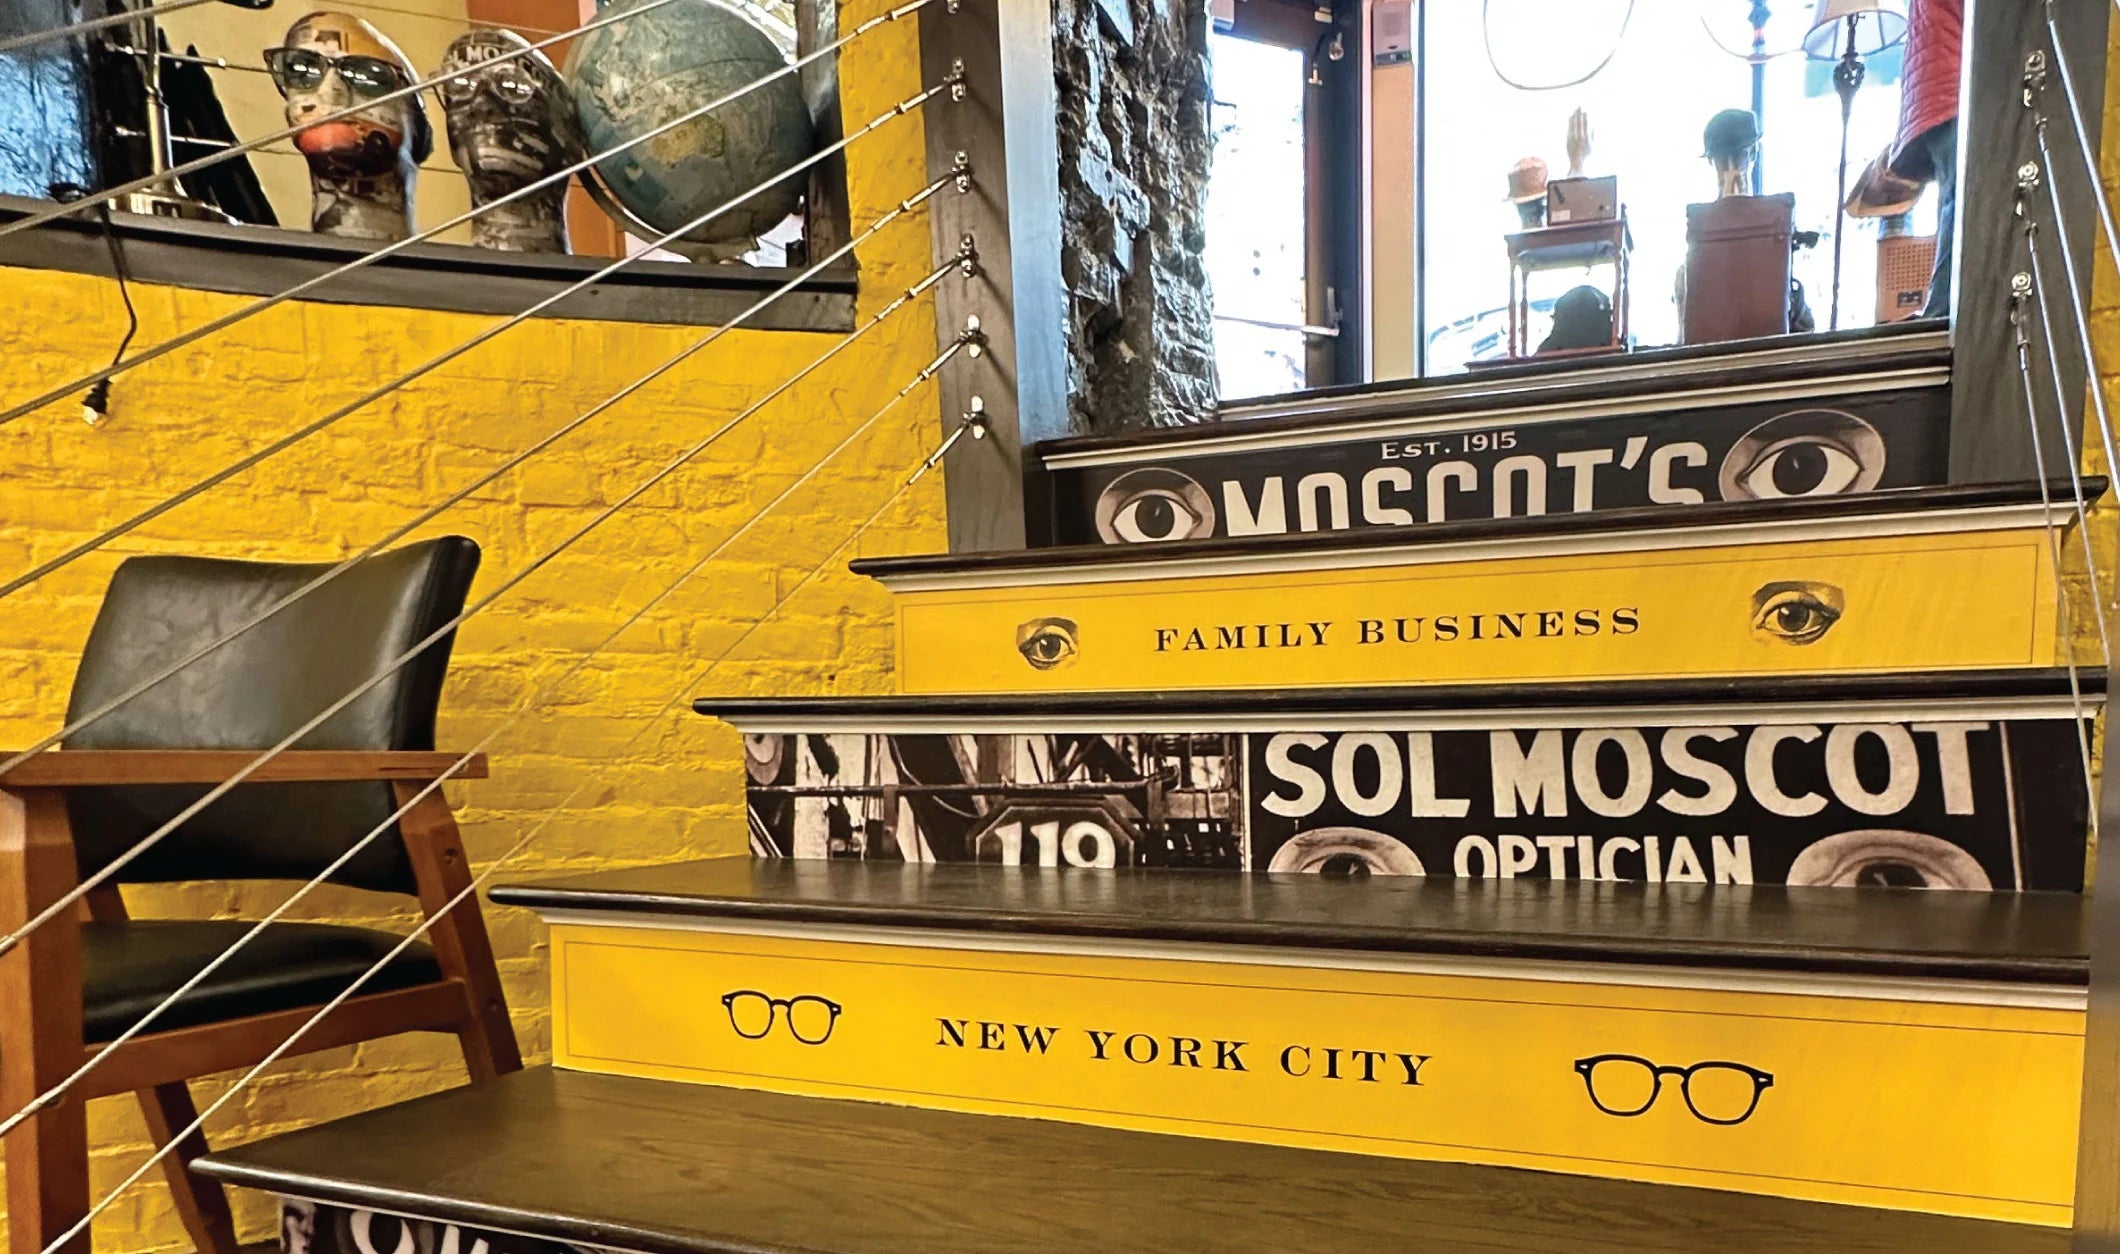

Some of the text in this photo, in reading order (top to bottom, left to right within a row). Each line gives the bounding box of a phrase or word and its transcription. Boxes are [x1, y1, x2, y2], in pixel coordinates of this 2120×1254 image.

[1381, 431, 1518, 460] EST. 1915
[1222, 436, 1708, 537] MOSCOT'S
[1154, 607, 1641, 652] FAMILY BUSINESS
[1260, 721, 1990, 818] SOL MOSCOT
[994, 821, 1116, 869] 119
[1453, 835, 1754, 886] OPTICIAN
[935, 1018, 1434, 1087] NEW YORK CITY
